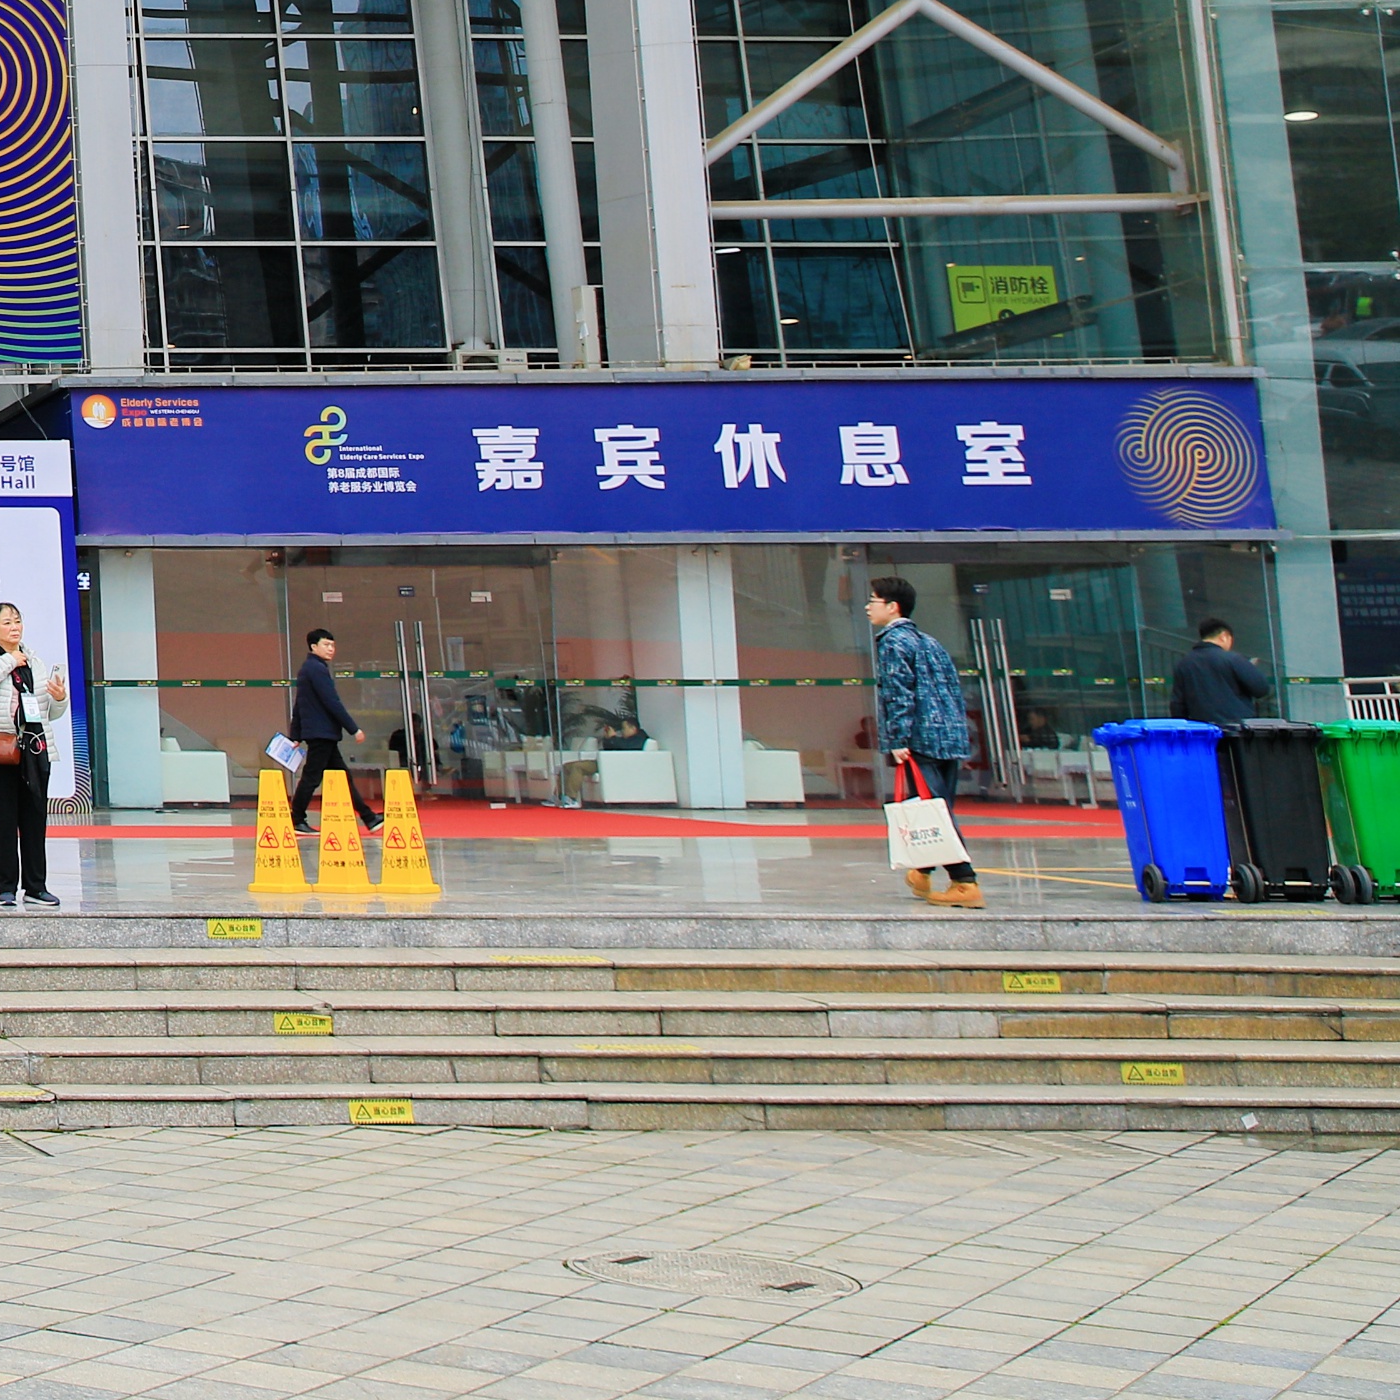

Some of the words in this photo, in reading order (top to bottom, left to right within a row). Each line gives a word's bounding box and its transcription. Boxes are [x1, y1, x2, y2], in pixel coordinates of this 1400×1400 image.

[989, 276, 1050, 295] 消防栓
[120, 398, 153, 409] Elderly
[155, 398, 199, 407] Services
[122, 408, 148, 417] Expo
[338, 445, 383, 453] International
[339, 453, 363, 462] Elderly
[363, 453, 378, 461] Care
[378, 453, 407, 461] Services
[408, 453, 425, 462] Expo
[472, 421, 1033, 492] 嘉宾休息室
[0, 455, 35, 473] 号馆
[326, 467, 400, 480] 第8届成都国际
[0, 475, 36, 489] Hall
[328, 481, 418, 493] 养老服务业博览会
